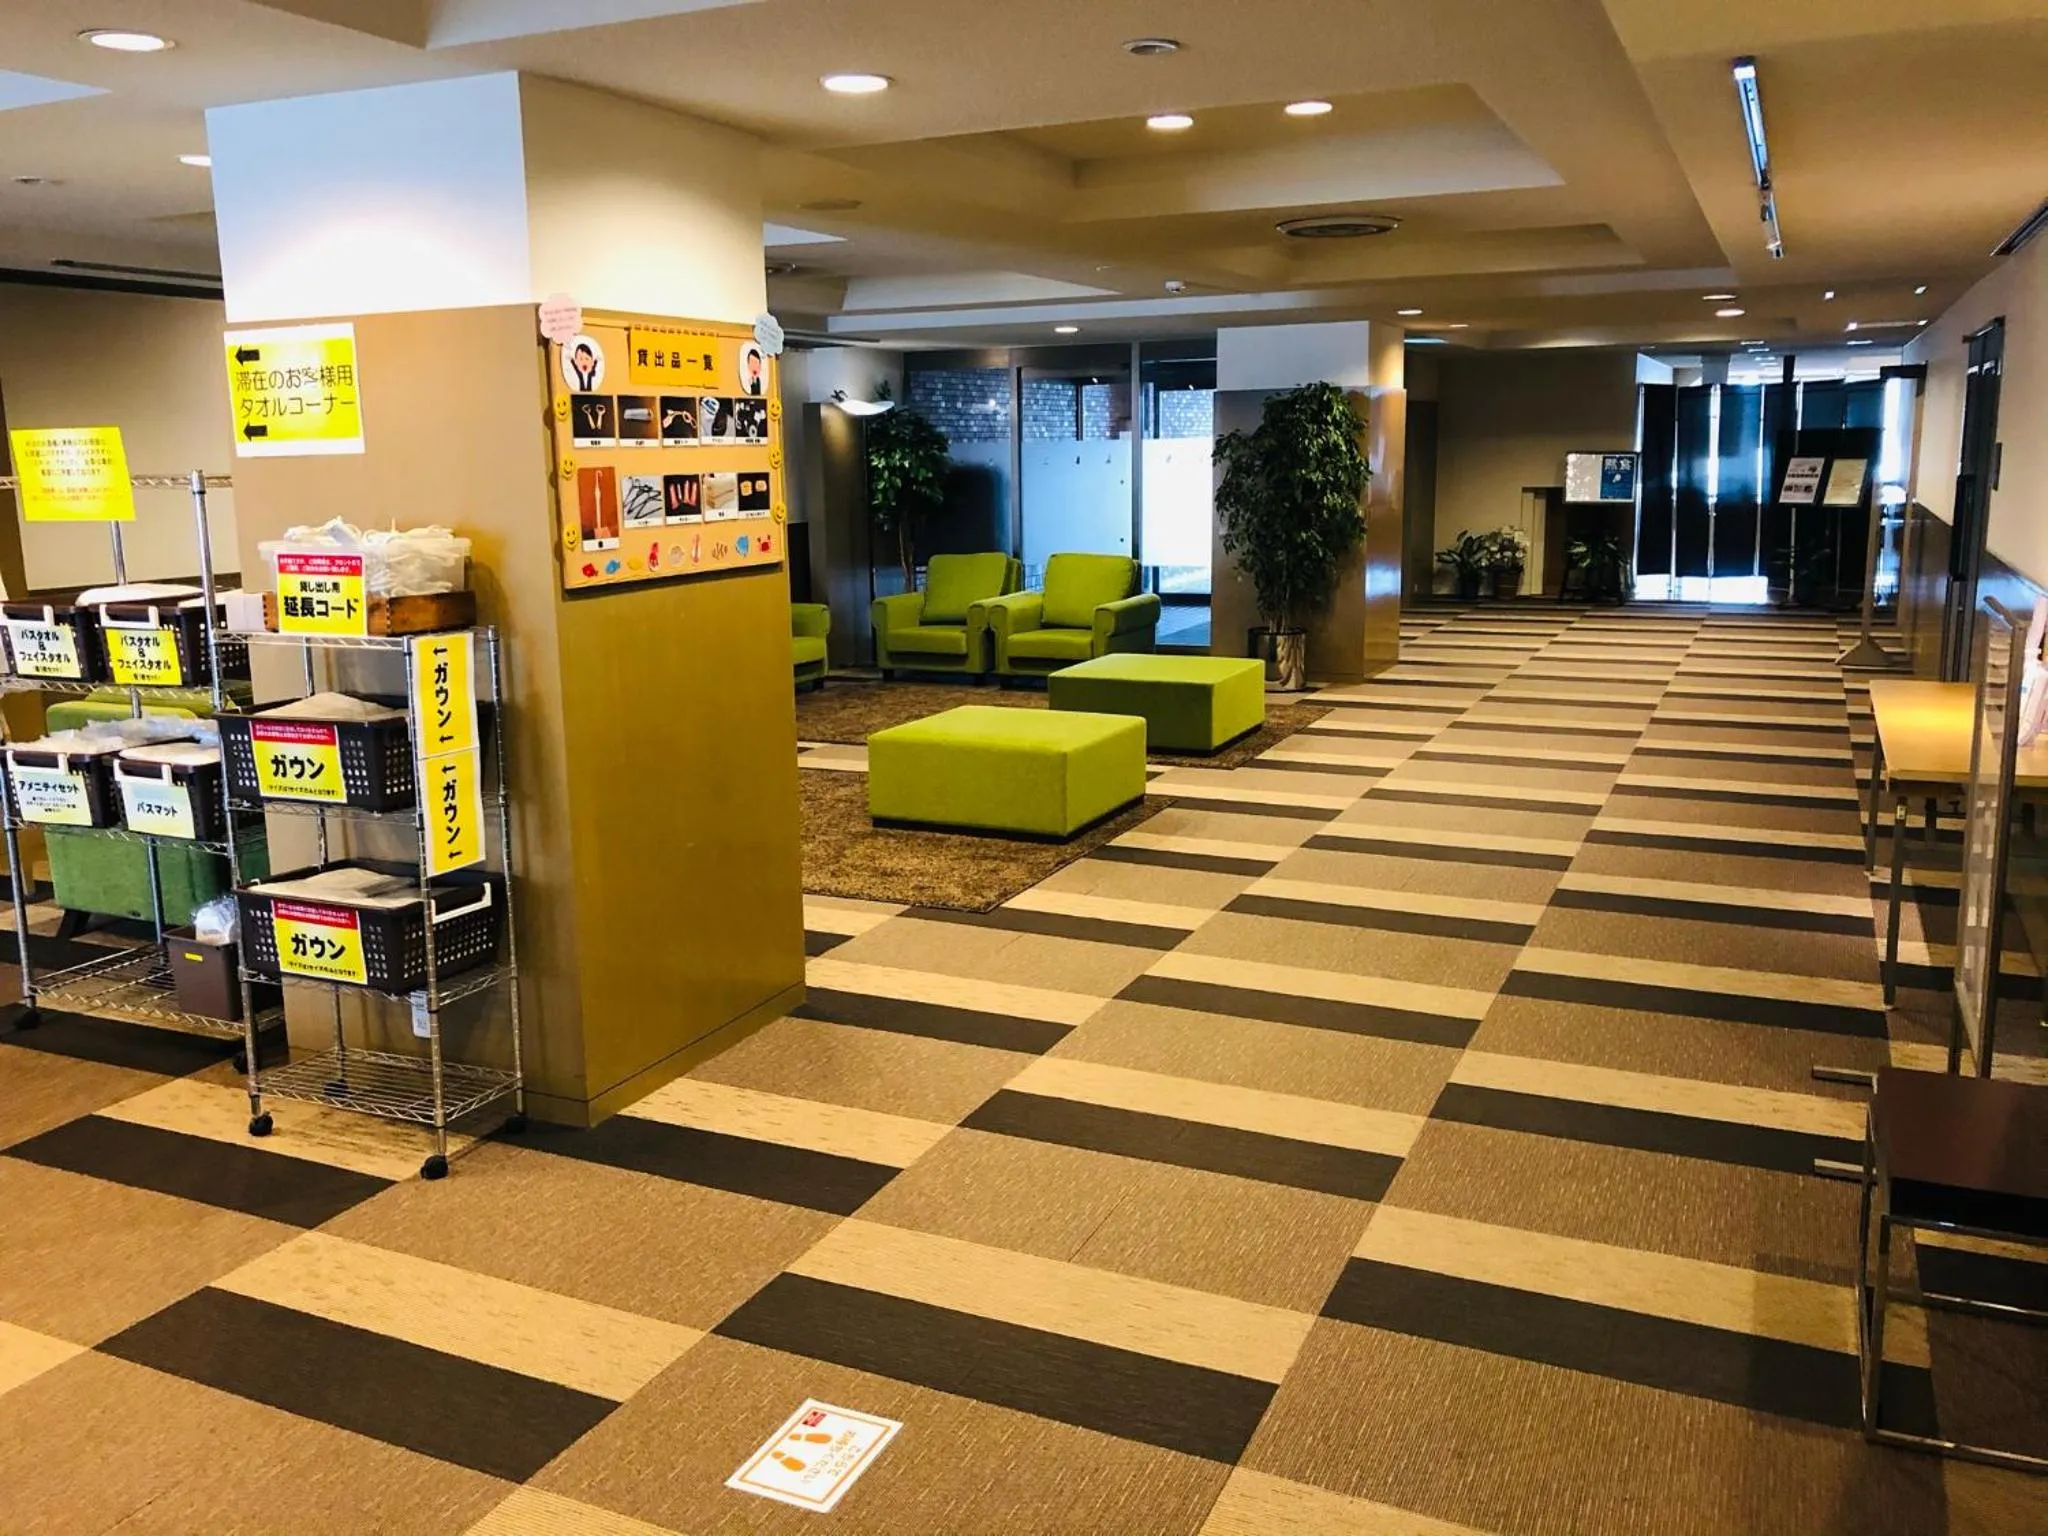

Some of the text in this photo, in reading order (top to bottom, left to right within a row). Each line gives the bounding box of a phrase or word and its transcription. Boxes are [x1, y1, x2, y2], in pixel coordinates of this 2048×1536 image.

[637, 348, 714, 371] 貸出品一覧
[236, 364, 353, 392] 滞在のお客様用
[240, 393, 355, 418] タオルコーナー
[300, 580, 341, 594] 貸し出し用
[283, 595, 360, 620] 延長コード
[21, 629, 60, 641] バスタオル
[120, 635, 161, 648] バスタオル
[434, 662, 452, 728] ガウン
[270, 754, 325, 780] ガウン
[18, 780, 80, 794] アメニティセット
[137, 801, 179, 818] バスマット
[442, 779, 461, 845] ガウン
[290, 932, 346, 960] ガウン
